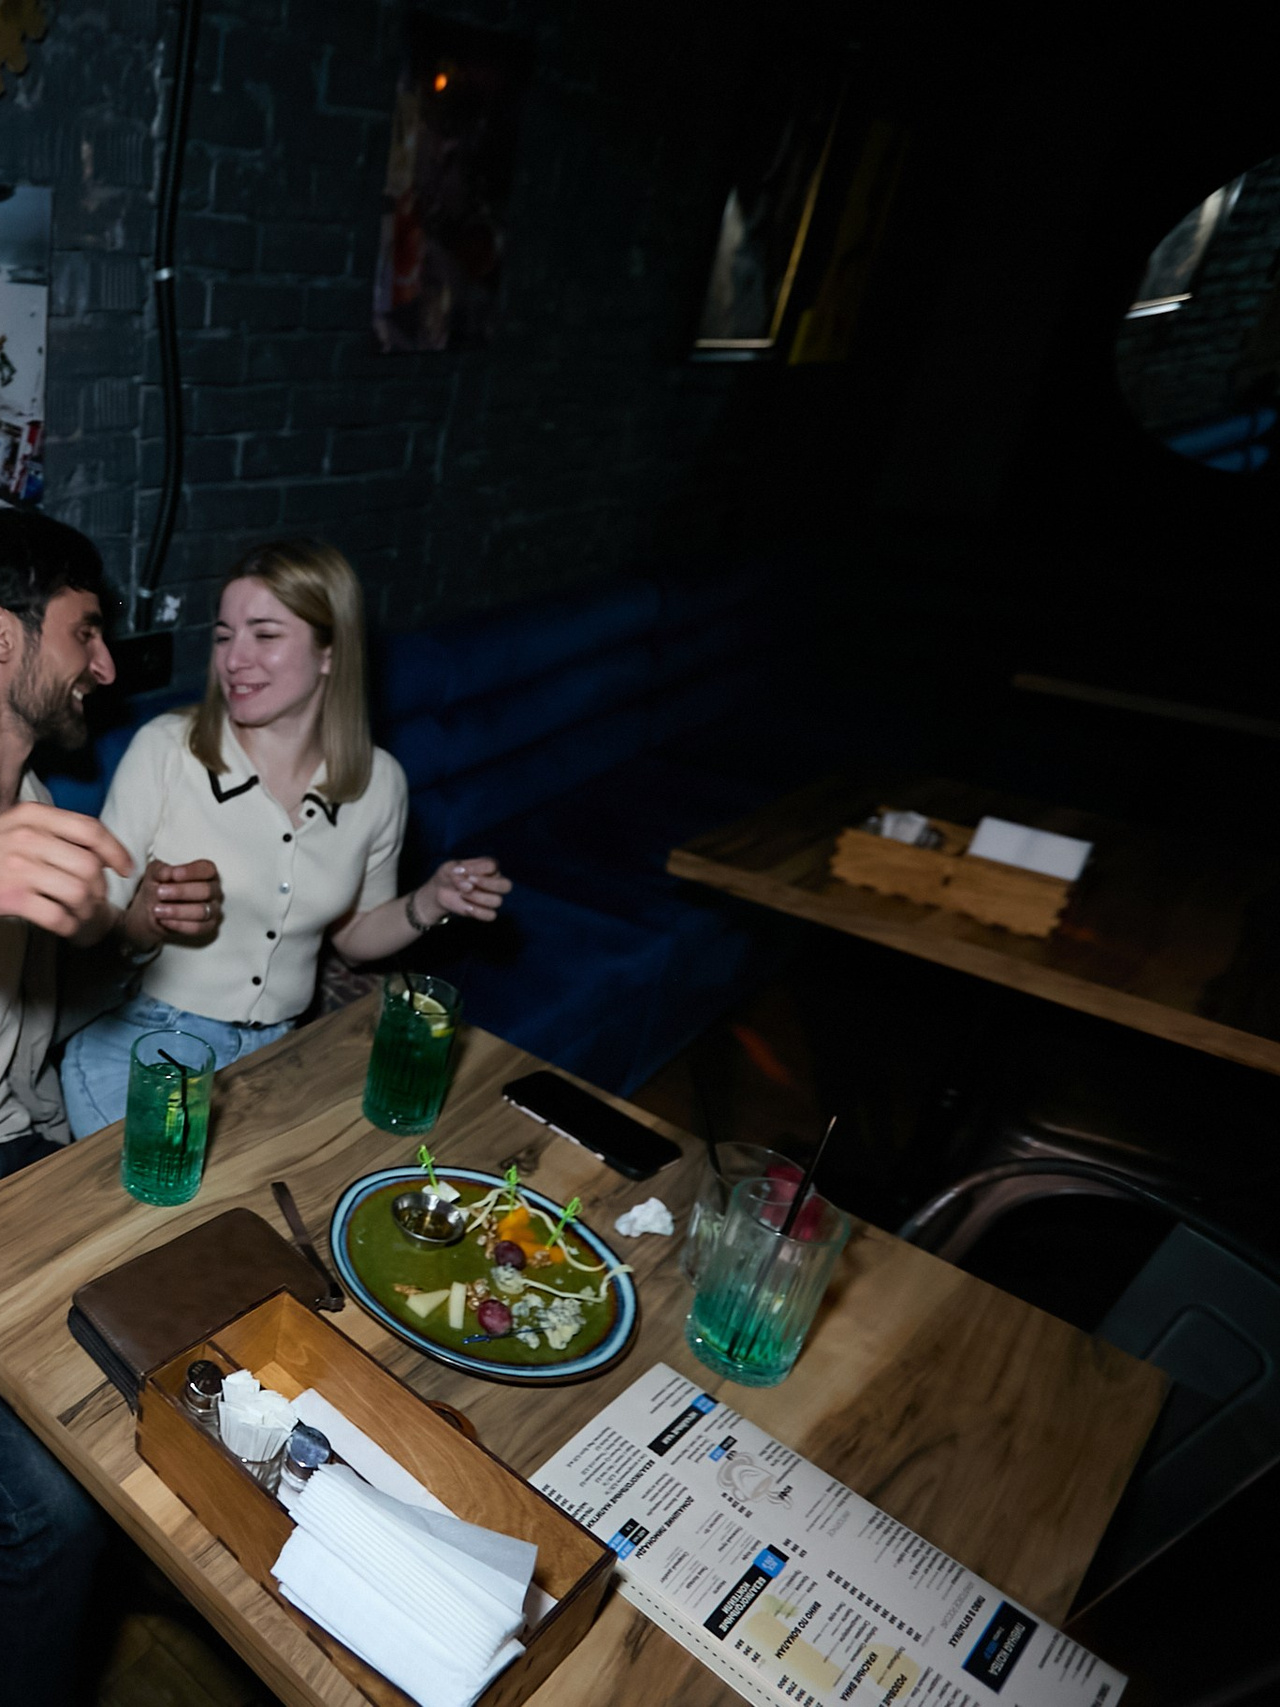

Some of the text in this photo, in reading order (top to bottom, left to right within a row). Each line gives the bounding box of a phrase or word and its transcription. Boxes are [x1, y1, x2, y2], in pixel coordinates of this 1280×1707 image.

[608, 1458, 656, 1503] БЕЗАЛКОГОЛЬНЫЕ
[776, 1484, 793, 1500] КОФЕ
[584, 1501, 613, 1528] НАПИТКИ
[662, 1495, 695, 1527] ДОМАШНИЕ
[632, 1524, 668, 1559] ЛИМОНАДЫ
[717, 1575, 767, 1632] БЕЗАЛКОГОЛЬНЫЕ
[720, 1581, 751, 1614] КОКТЕЙЛИ
[804, 1600, 821, 1619] ВИНО
[970, 1594, 985, 1612] ПИВО
[797, 1617, 809, 1629] ПО
[947, 1613, 973, 1648] БУТЫЛКАХ
[1002, 1621, 1026, 1652] ПИВНАЯ
[773, 1626, 802, 1659] БОКАЛАМ
[852, 1651, 878, 1683] КРАСНЫЕ
[987, 1648, 1010, 1677] КОЛБА
[776, 1674, 789, 1689] 2800
[784, 1681, 797, 1696] 2700
[839, 1681, 857, 1702] ВИНА
[882, 1673, 907, 1706] РОЗОВЫЕ
